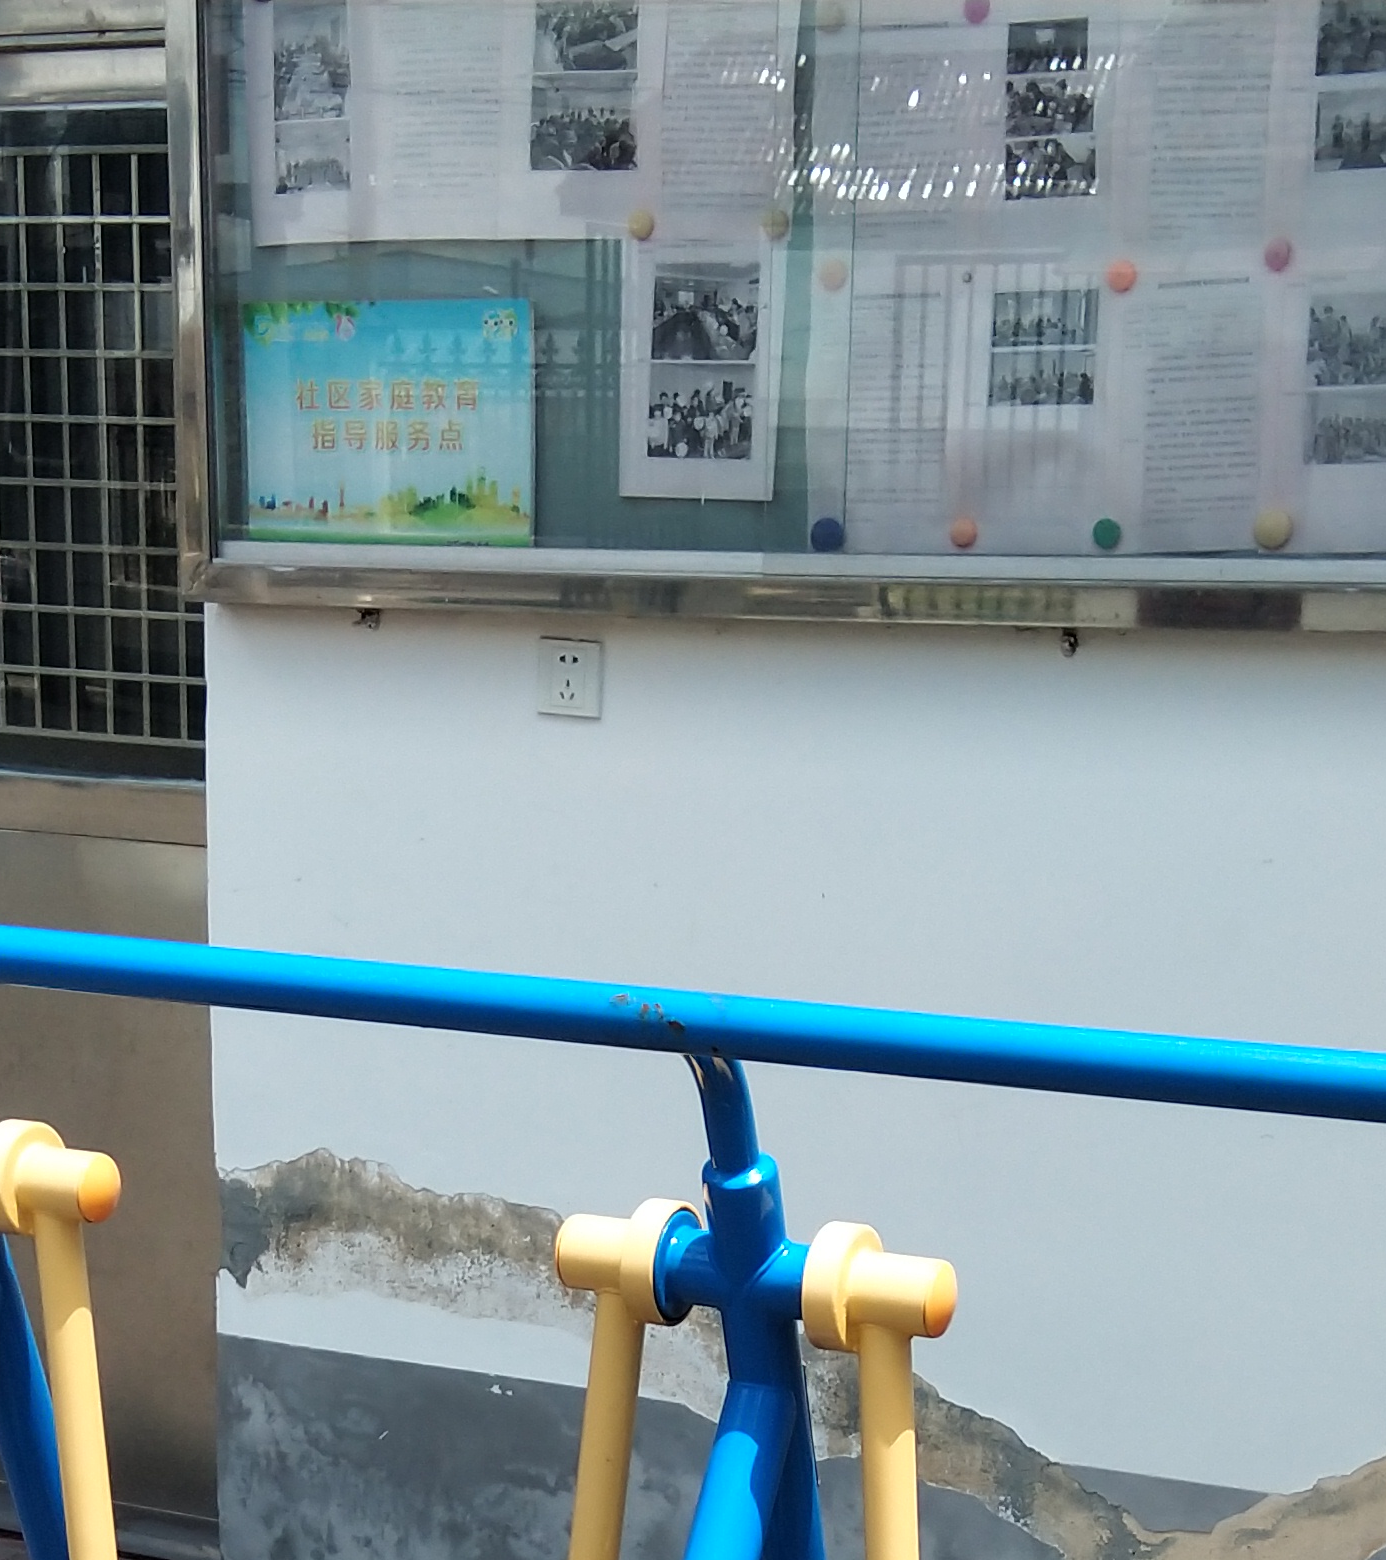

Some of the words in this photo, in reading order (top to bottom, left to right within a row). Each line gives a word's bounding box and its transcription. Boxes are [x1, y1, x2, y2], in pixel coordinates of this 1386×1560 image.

[295, 377, 480, 411] 社区家庭教育
[311, 420, 463, 452] 指导服务点
